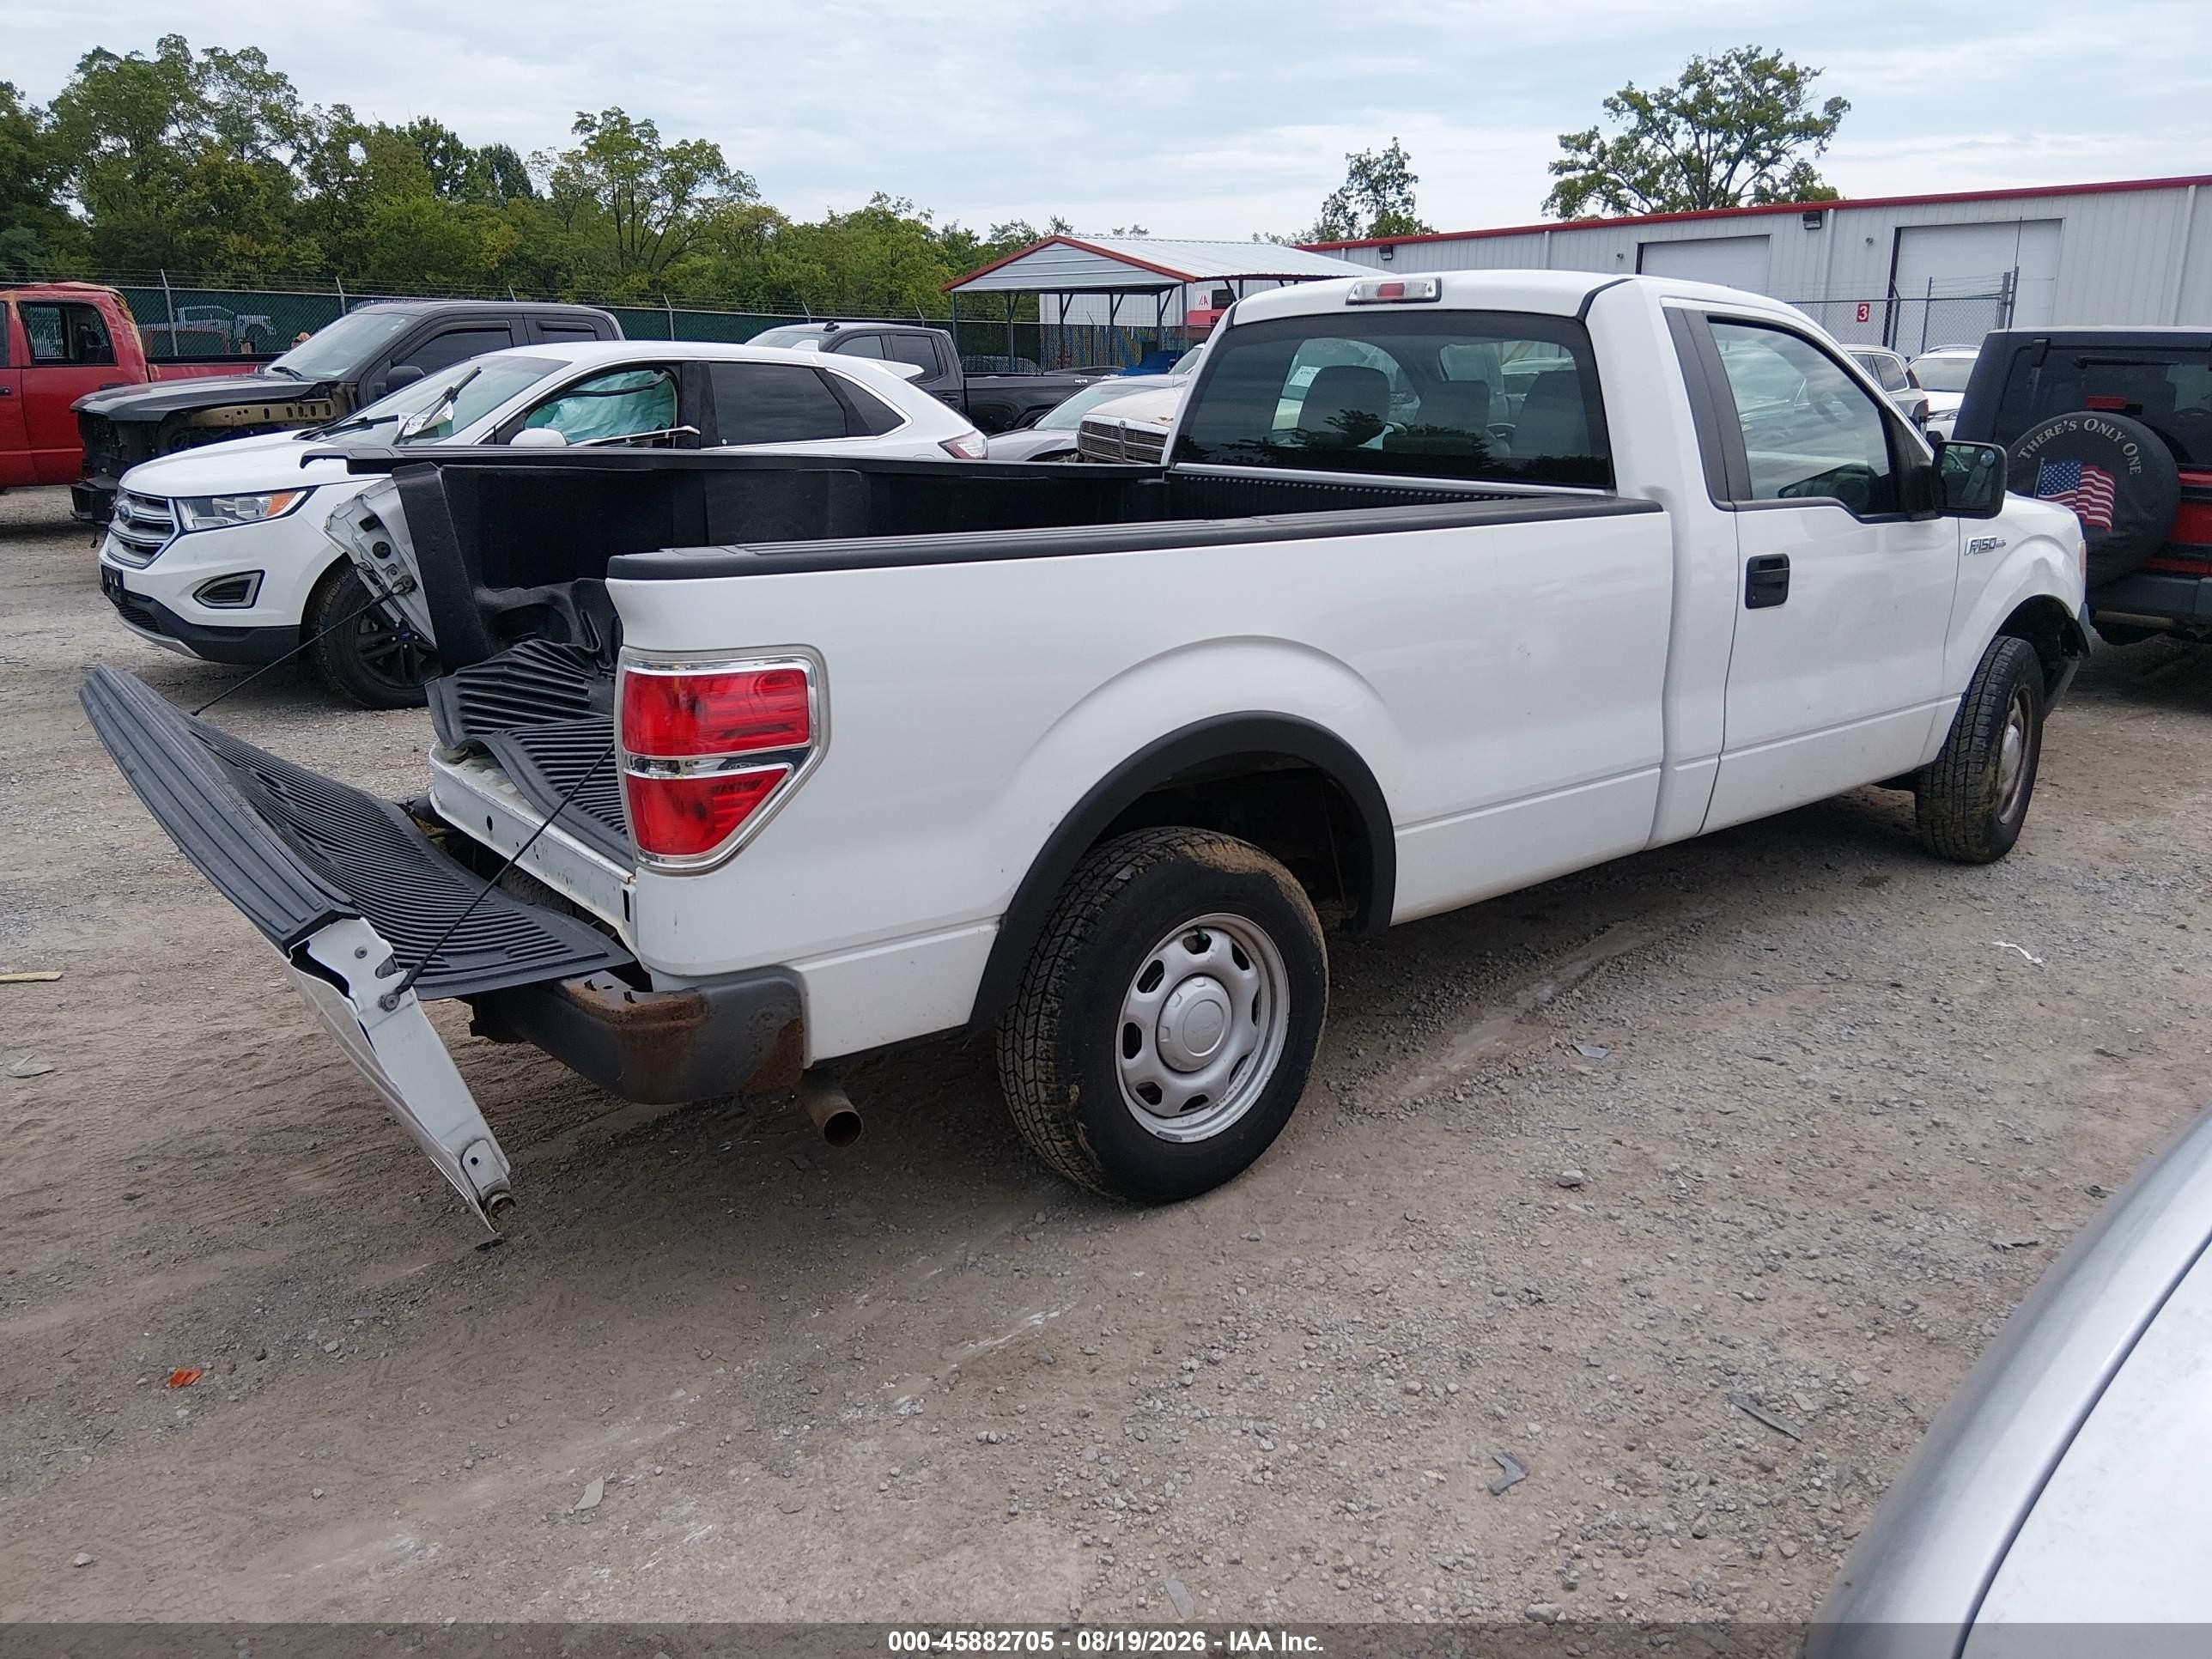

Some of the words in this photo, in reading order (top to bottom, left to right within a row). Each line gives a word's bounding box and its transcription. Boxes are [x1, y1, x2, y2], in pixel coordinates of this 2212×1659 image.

[1858, 305, 1868, 320] 3
[2018, 420, 2077, 459] THERE'S
[2084, 418, 2126, 442] ONLY
[2122, 442, 2142, 475] ONE
